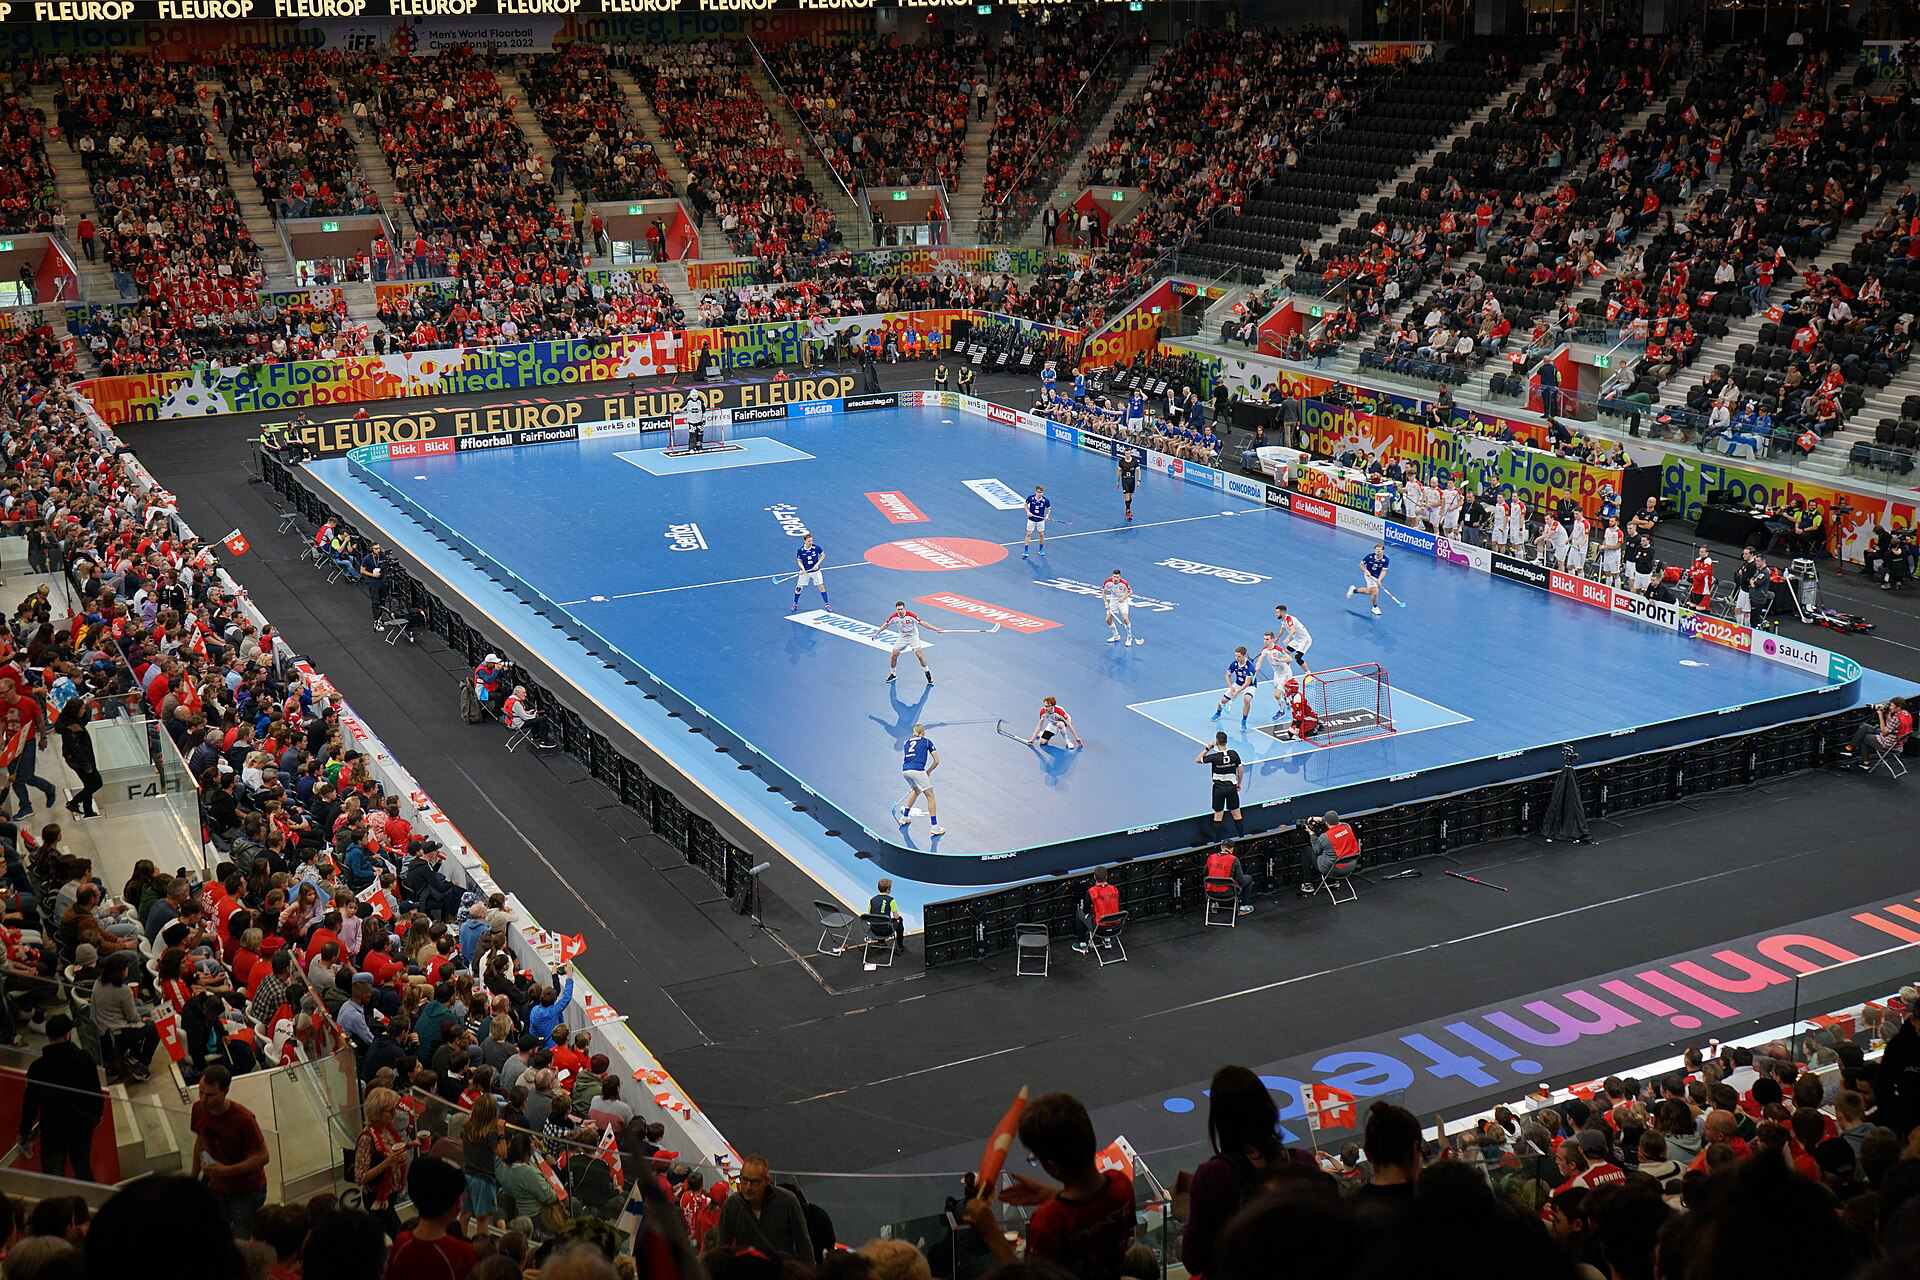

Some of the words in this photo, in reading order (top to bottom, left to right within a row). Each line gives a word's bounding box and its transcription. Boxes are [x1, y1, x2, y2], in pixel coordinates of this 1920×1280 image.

[35, 1, 136, 21] FLEUROP
[158, 0, 254, 20] FLEUROP
[274, 0, 367, 18] FLEUROP
[390, 0, 478, 16] FLEUROP
[498, 0, 582, 14] FLEUROP
[601, 0, 682, 13] FLEUROP
[430, 30, 456, 39] Men's
[458, 29, 488, 39] World
[491, 28, 533, 38] Floorball
[511, 38, 534, 48] 2022
[302, 416, 438, 453] FLEUROP
[456, 403, 583, 437] FLEUROP
[740, 380, 856, 409] FLEUROP
[735, 408, 785, 421] FairFloorball
[641, 419, 671, 432] Zürich
[460, 433, 513, 452] #floorball
[520, 430, 577, 444] FairFloorball
[392, 444, 416, 456] Blick
[424, 441, 449, 453] Blick
[1228, 480, 1261, 498] CONCORDIA
[1267, 491, 1290, 507] Zürich
[1295, 501, 1305, 511] die
[1304, 502, 1332, 520] Mobiliar
[1337, 511, 1384, 534] FLEUROPHOME
[1384, 526, 1436, 552] ticketmaster
[1437, 538, 1449, 550] GO
[1437, 547, 1451, 560] OST
[1551, 575, 1575, 594] Blick
[1582, 584, 1607, 605] Blick
[1615, 596, 1629, 608] SRF
[1628, 598, 1677, 627] SPORT
[1680, 615, 1750, 647] wfc2022.ch
[1779, 643, 1818, 665] sau.ch
[907, 740, 917, 753] 2
[128, 782, 160, 800] F4
